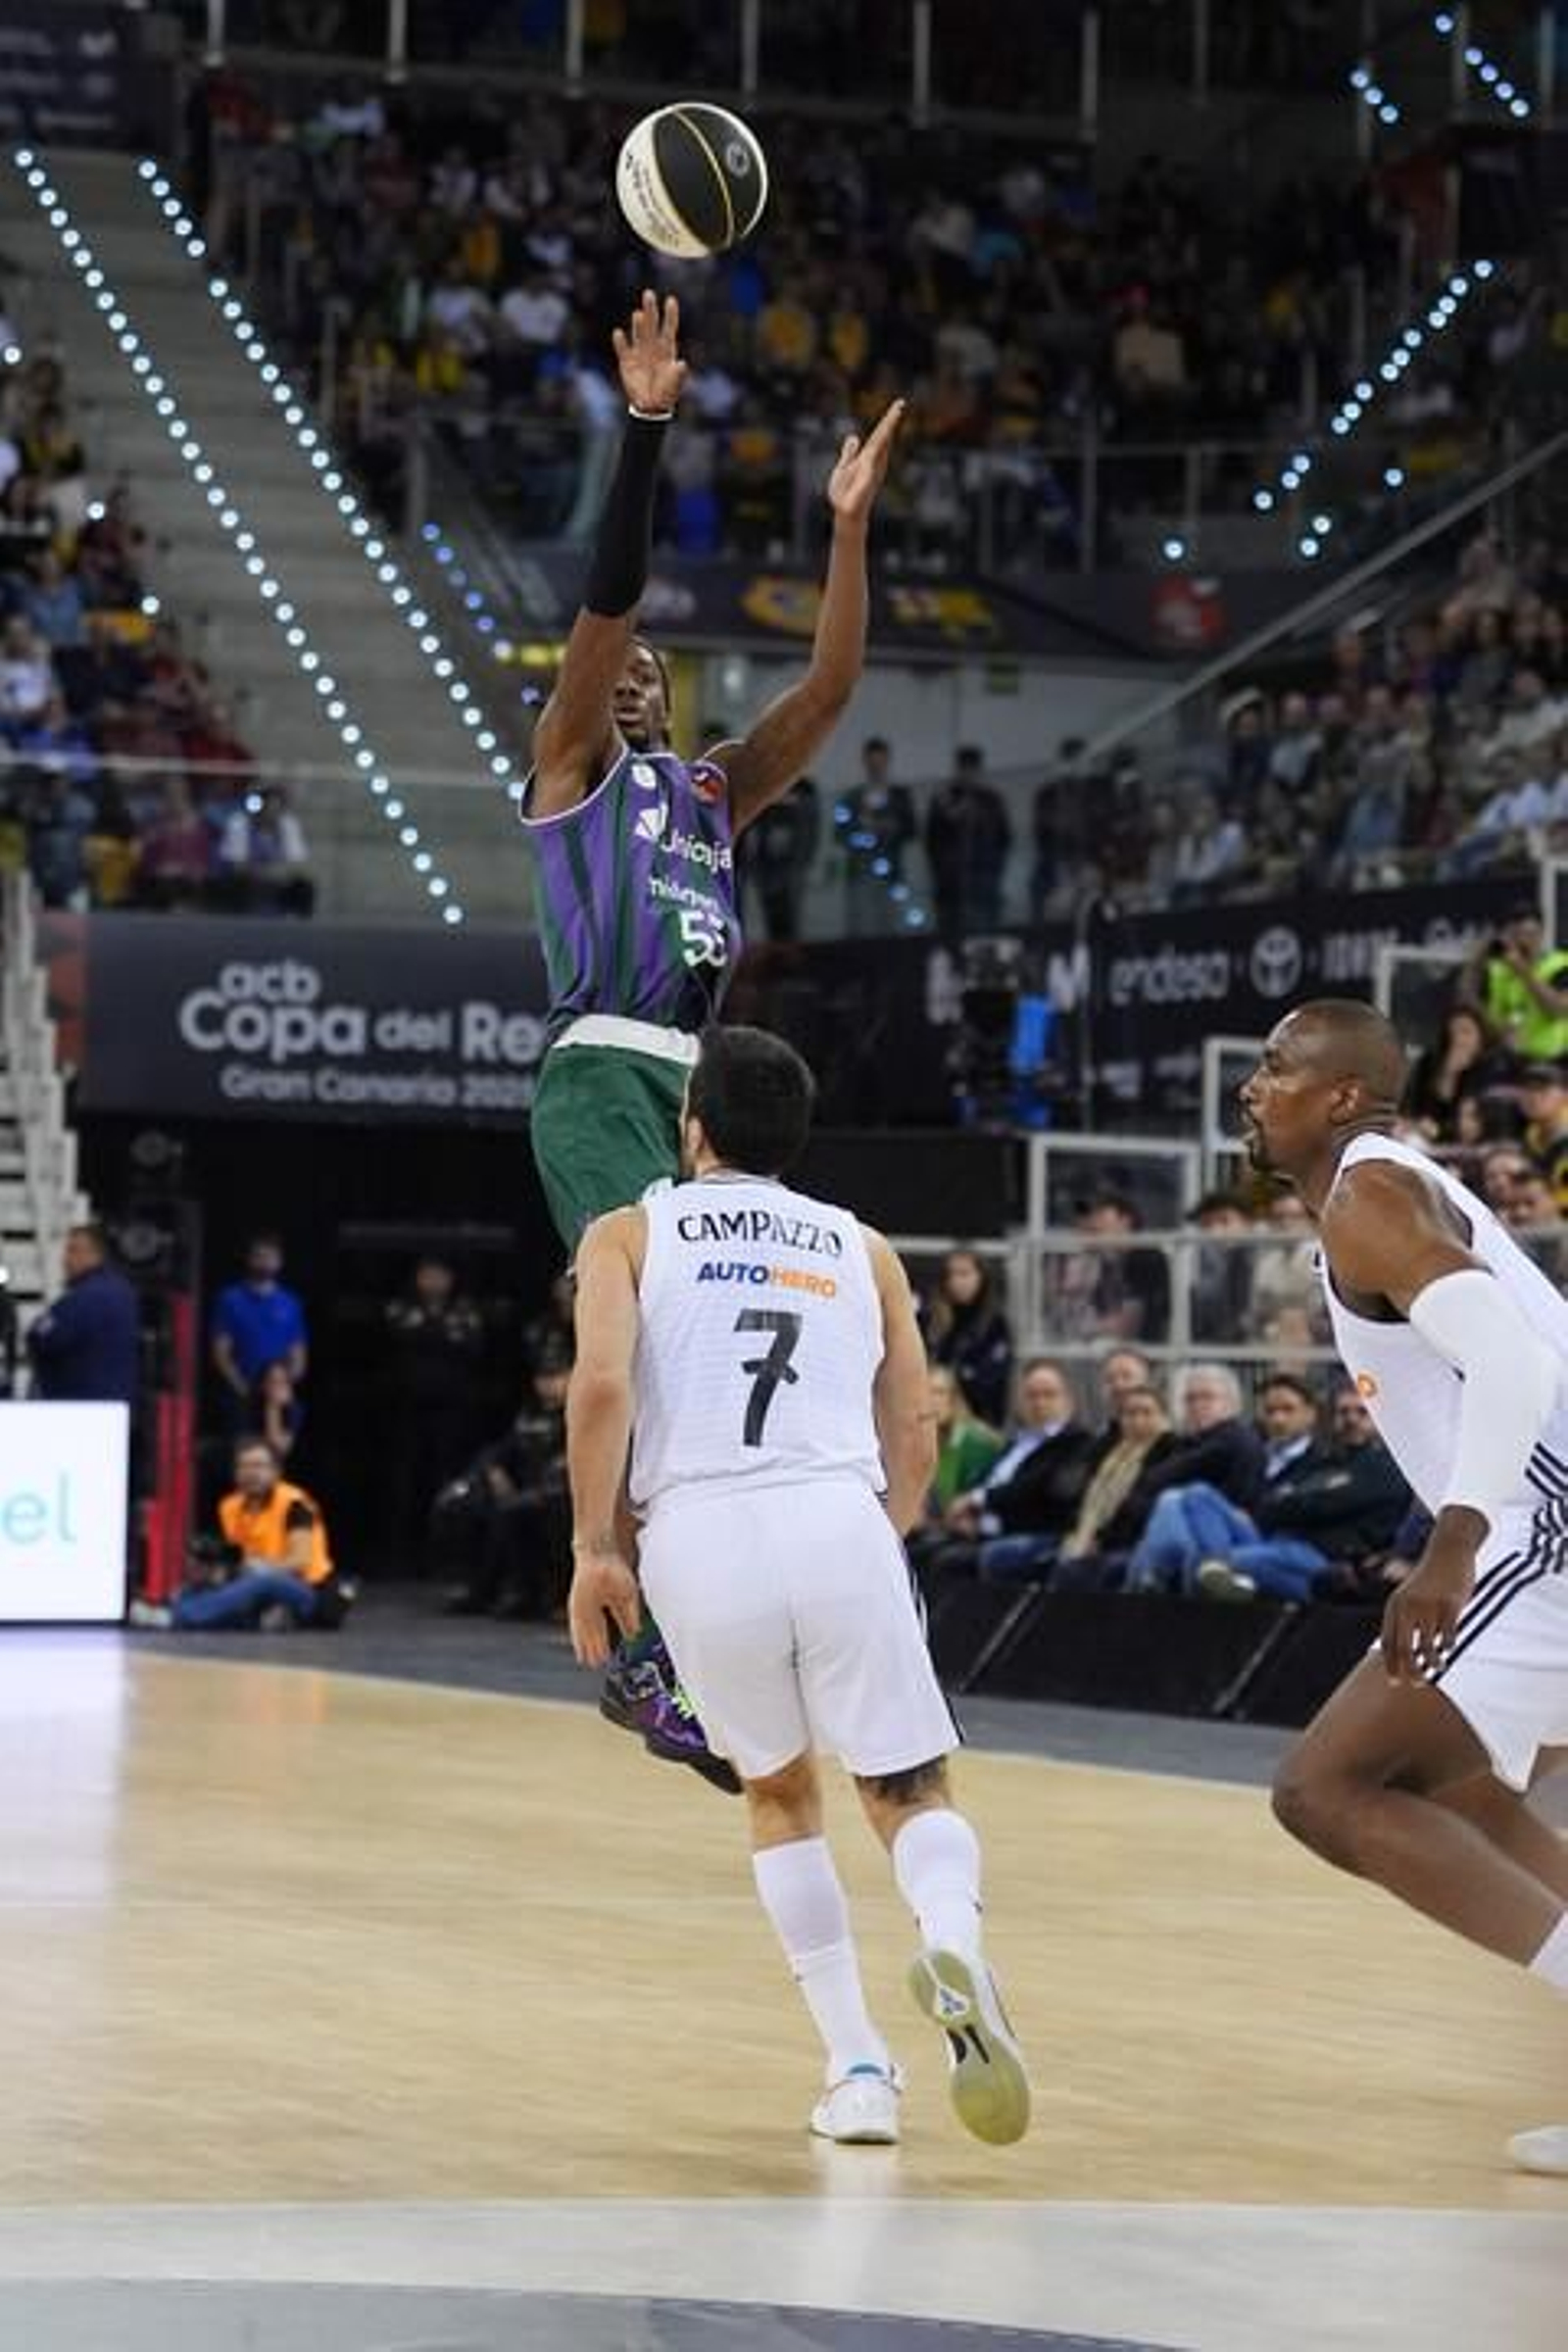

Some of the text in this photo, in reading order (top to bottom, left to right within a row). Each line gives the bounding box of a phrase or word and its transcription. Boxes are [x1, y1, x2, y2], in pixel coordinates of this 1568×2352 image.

[220, 959, 319, 1004] acb
[179, 990, 546, 1063] Copa del Re
[220, 1064, 311, 1099] Gran
[315, 1068, 456, 1104] Canaria
[676, 1210, 843, 1258] CAMPAZZO
[696, 1261, 836, 1298] AUTOHERO
[734, 1308, 803, 1447] 7
